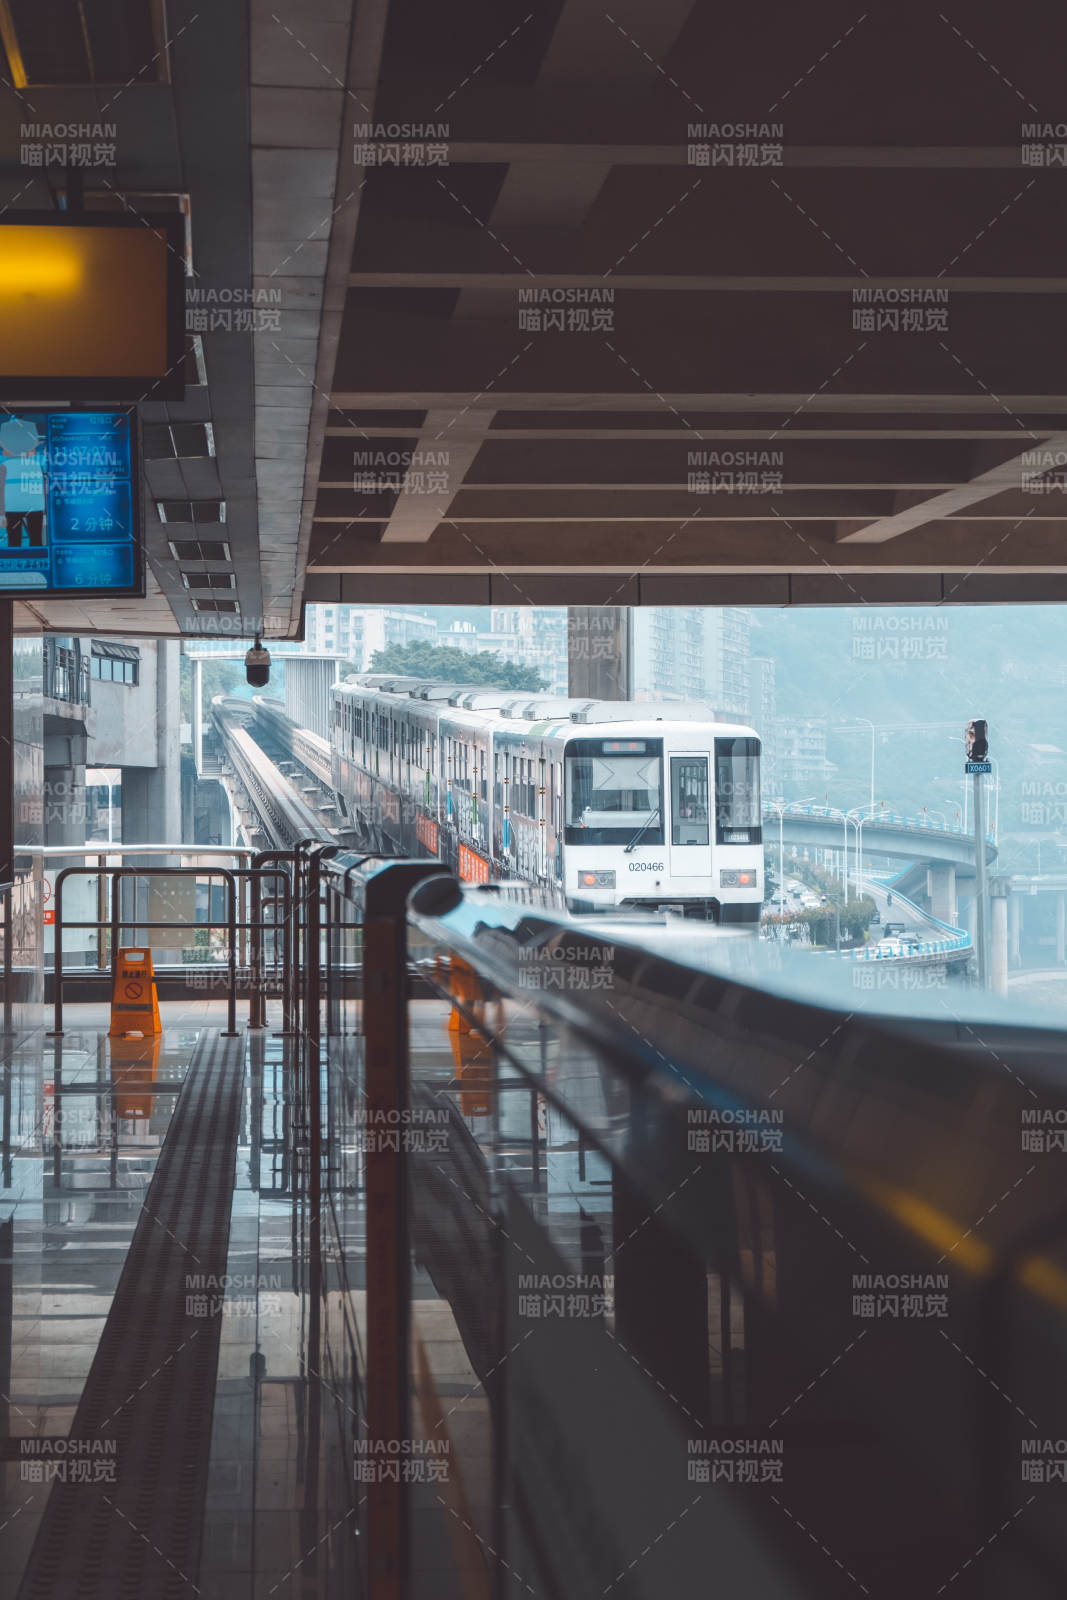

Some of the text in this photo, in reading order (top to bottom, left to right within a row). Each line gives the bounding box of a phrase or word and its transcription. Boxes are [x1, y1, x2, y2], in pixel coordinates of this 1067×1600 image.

[71, 517, 113, 532] 2 分钟
[628, 862, 664, 871] 020466
